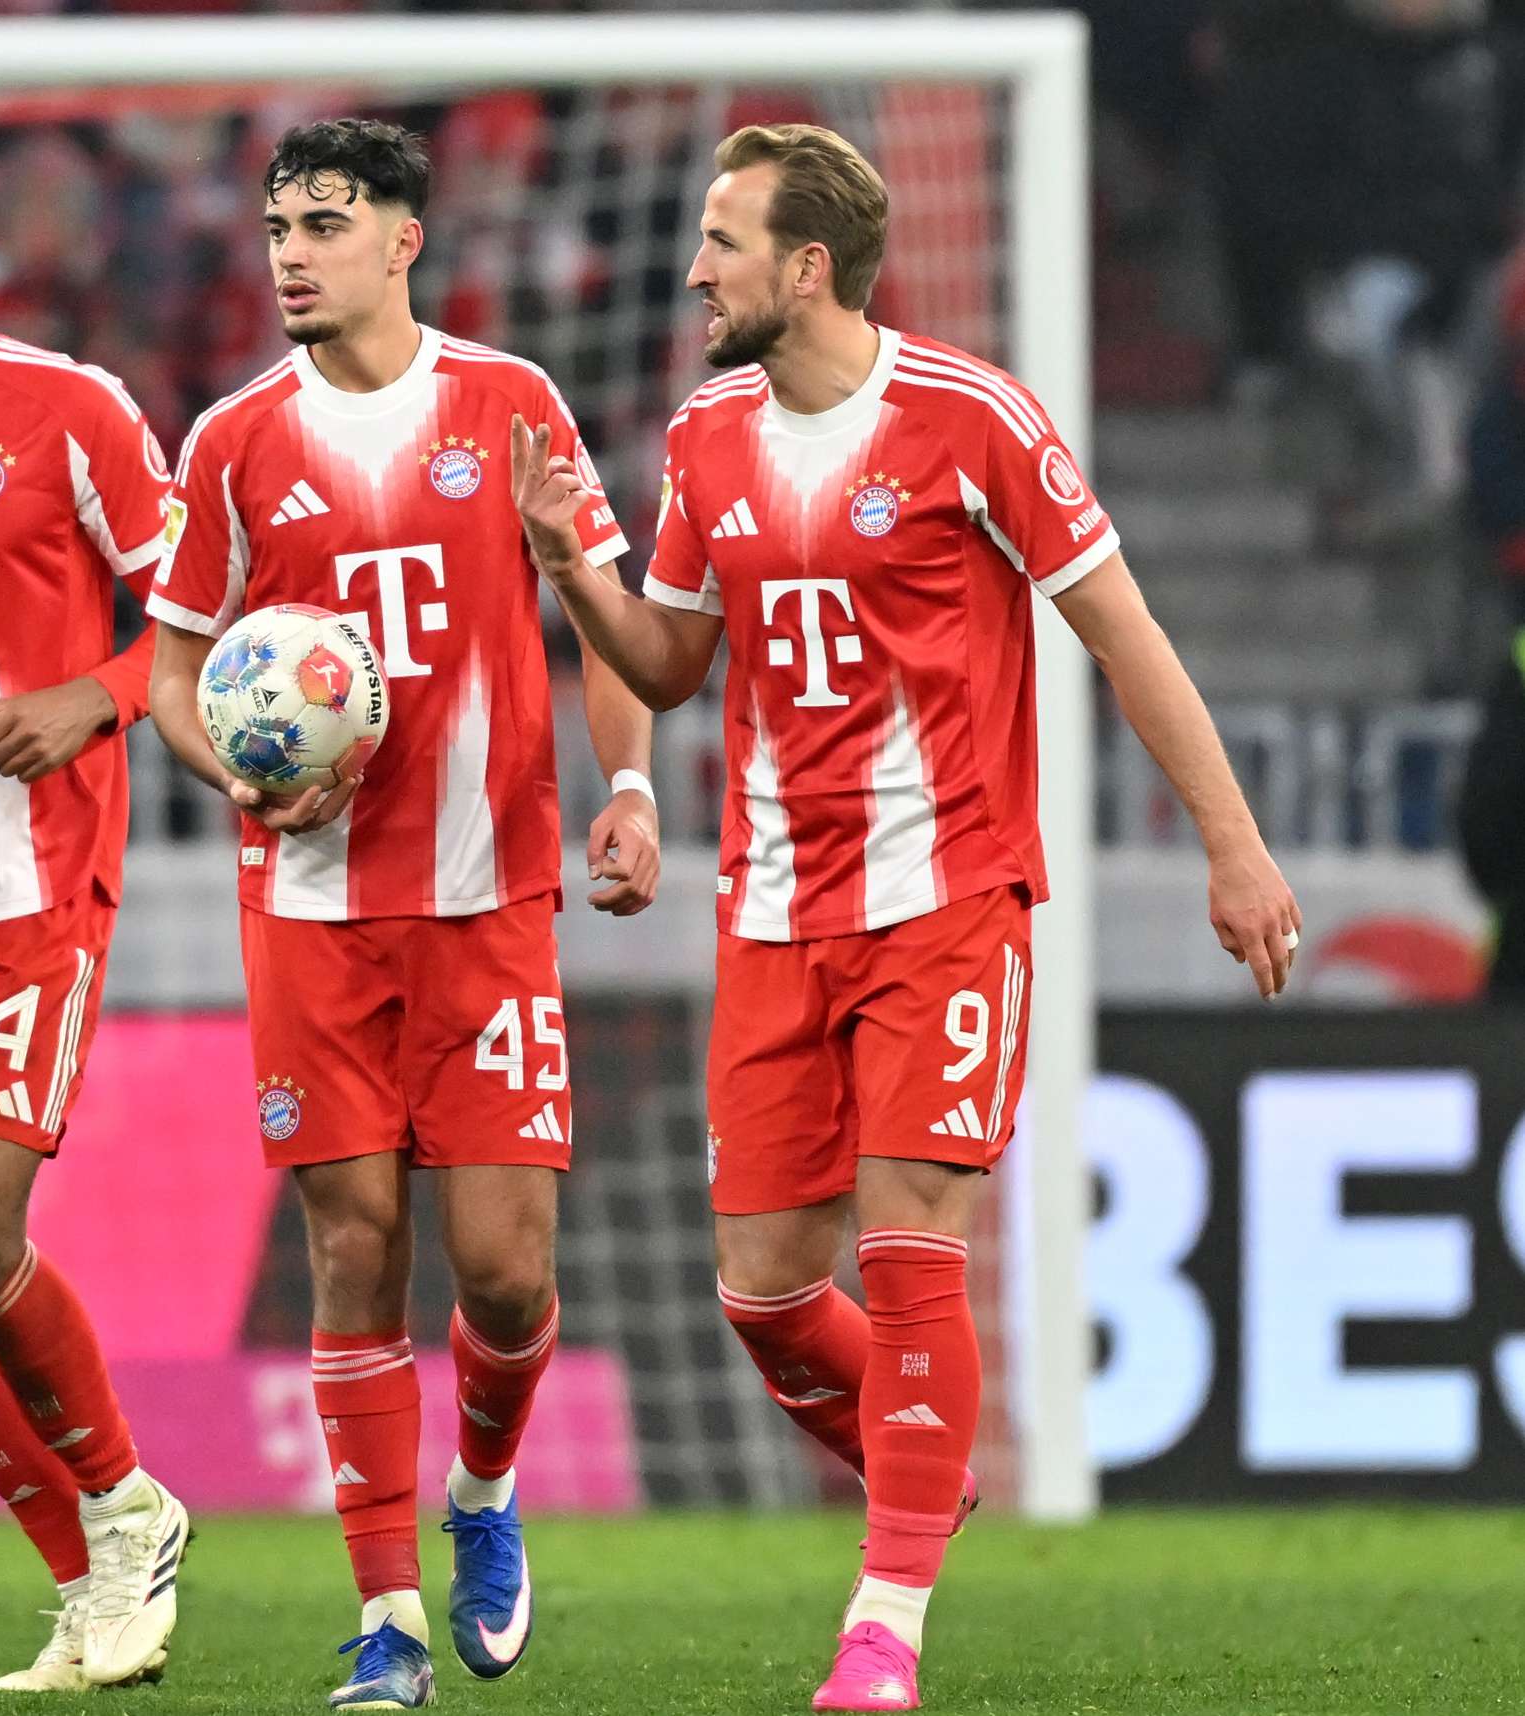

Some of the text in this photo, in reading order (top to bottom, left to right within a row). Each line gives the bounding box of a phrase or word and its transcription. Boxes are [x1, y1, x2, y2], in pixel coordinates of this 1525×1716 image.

[443, 453, 476, 470] BAYERN
[866, 490, 895, 510] BAYERN
[335, 543, 448, 678] T
[761, 578, 863, 707] T
[251, 687, 265, 714] SELECT
[338, 623, 382, 725] DERBYSTAR
[475, 996, 567, 1091] 45
[942, 989, 990, 1083] 9
[1005, 1070, 1525, 1472] BE
